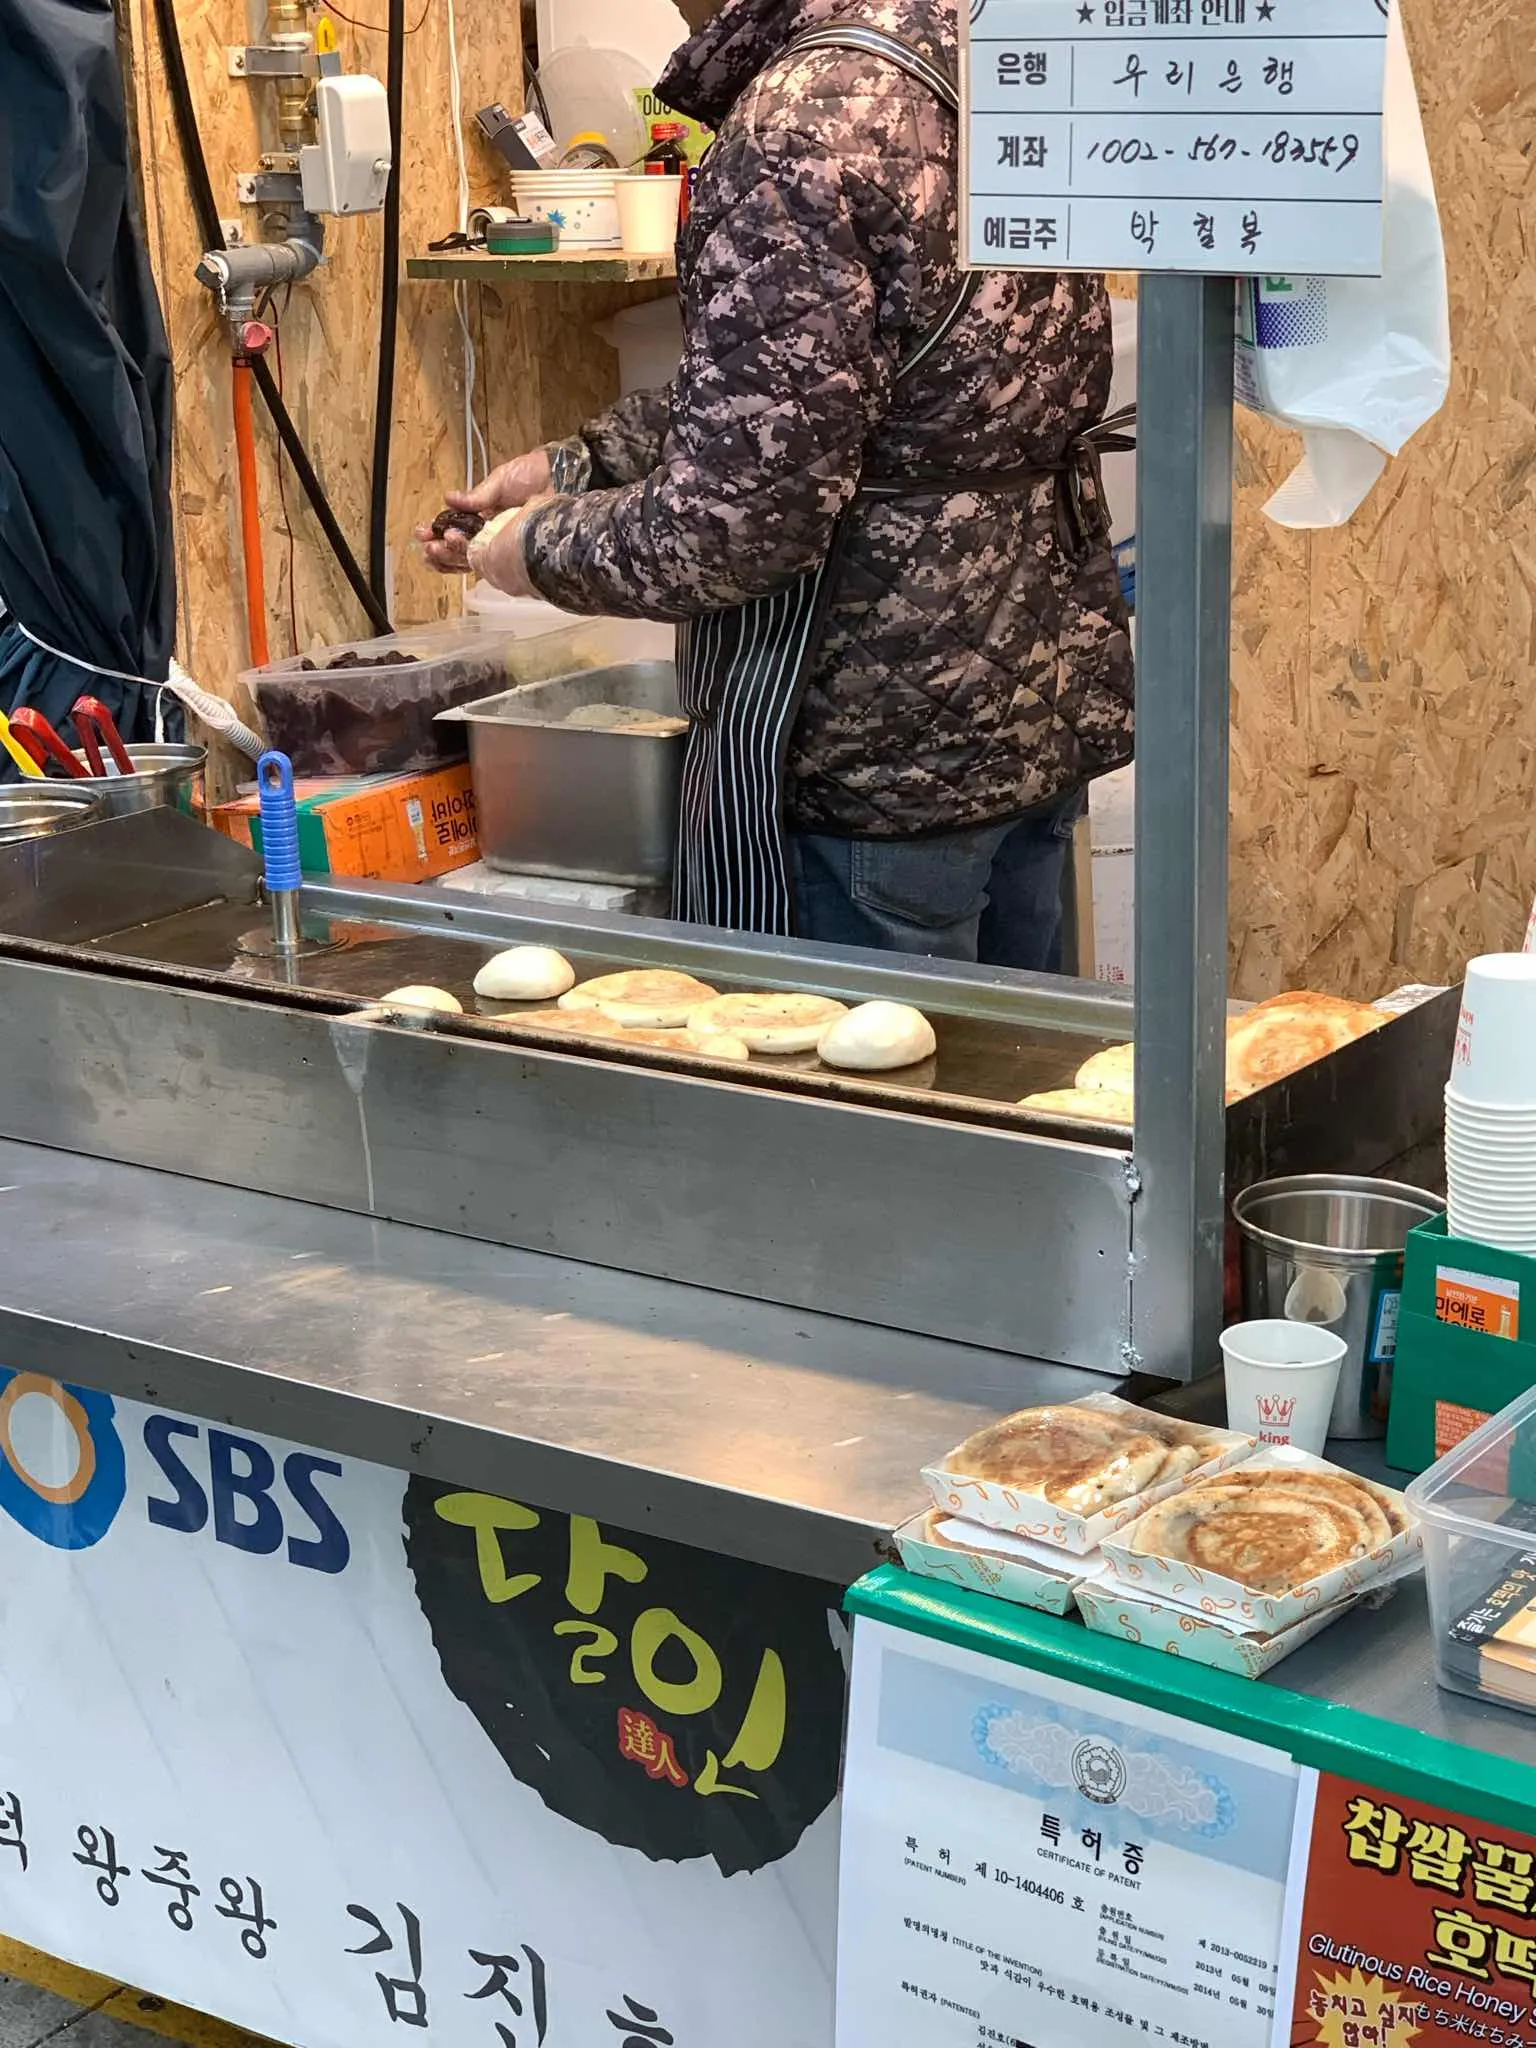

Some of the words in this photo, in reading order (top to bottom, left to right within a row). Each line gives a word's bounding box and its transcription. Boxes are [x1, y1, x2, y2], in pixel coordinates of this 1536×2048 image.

[1104, 0, 1192, 27] 입금계좌
[1201, 0, 1247, 26] 안내
[997, 51, 1048, 87] 은행
[997, 135, 1048, 168] 계좌
[983, 216, 1058, 250] 예금주
[1259, 1430, 1290, 1447] king
[143, 1414, 351, 1575] SBS
[1040, 1813, 1145, 1876] 특허증
[1343, 1797, 1536, 1914] 찹쌀꿀
[974, 1862, 987, 1879] 제
[994, 1868, 1065, 1904] 10-1404406
[1071, 1895, 1085, 1912] 호
[1036, 1847, 1091, 1873] CERTIFICATE
[1093, 1867, 1105, 1878] OF
[1108, 1871, 1142, 1891] PATENT
[73, 1824, 277, 1959] 왕중왕
[975, 1945, 985, 1954] OF
[987, 1949, 1001, 1961] THE
[1308, 1933, 1403, 1981] Glutinous
[1406, 1966, 1452, 1996] Rice
[1455, 1982, 1527, 2024] Honey
[1154, 2025, 1164, 2036] 그
[1416, 2002, 1536, 2048] もち米はちみ
